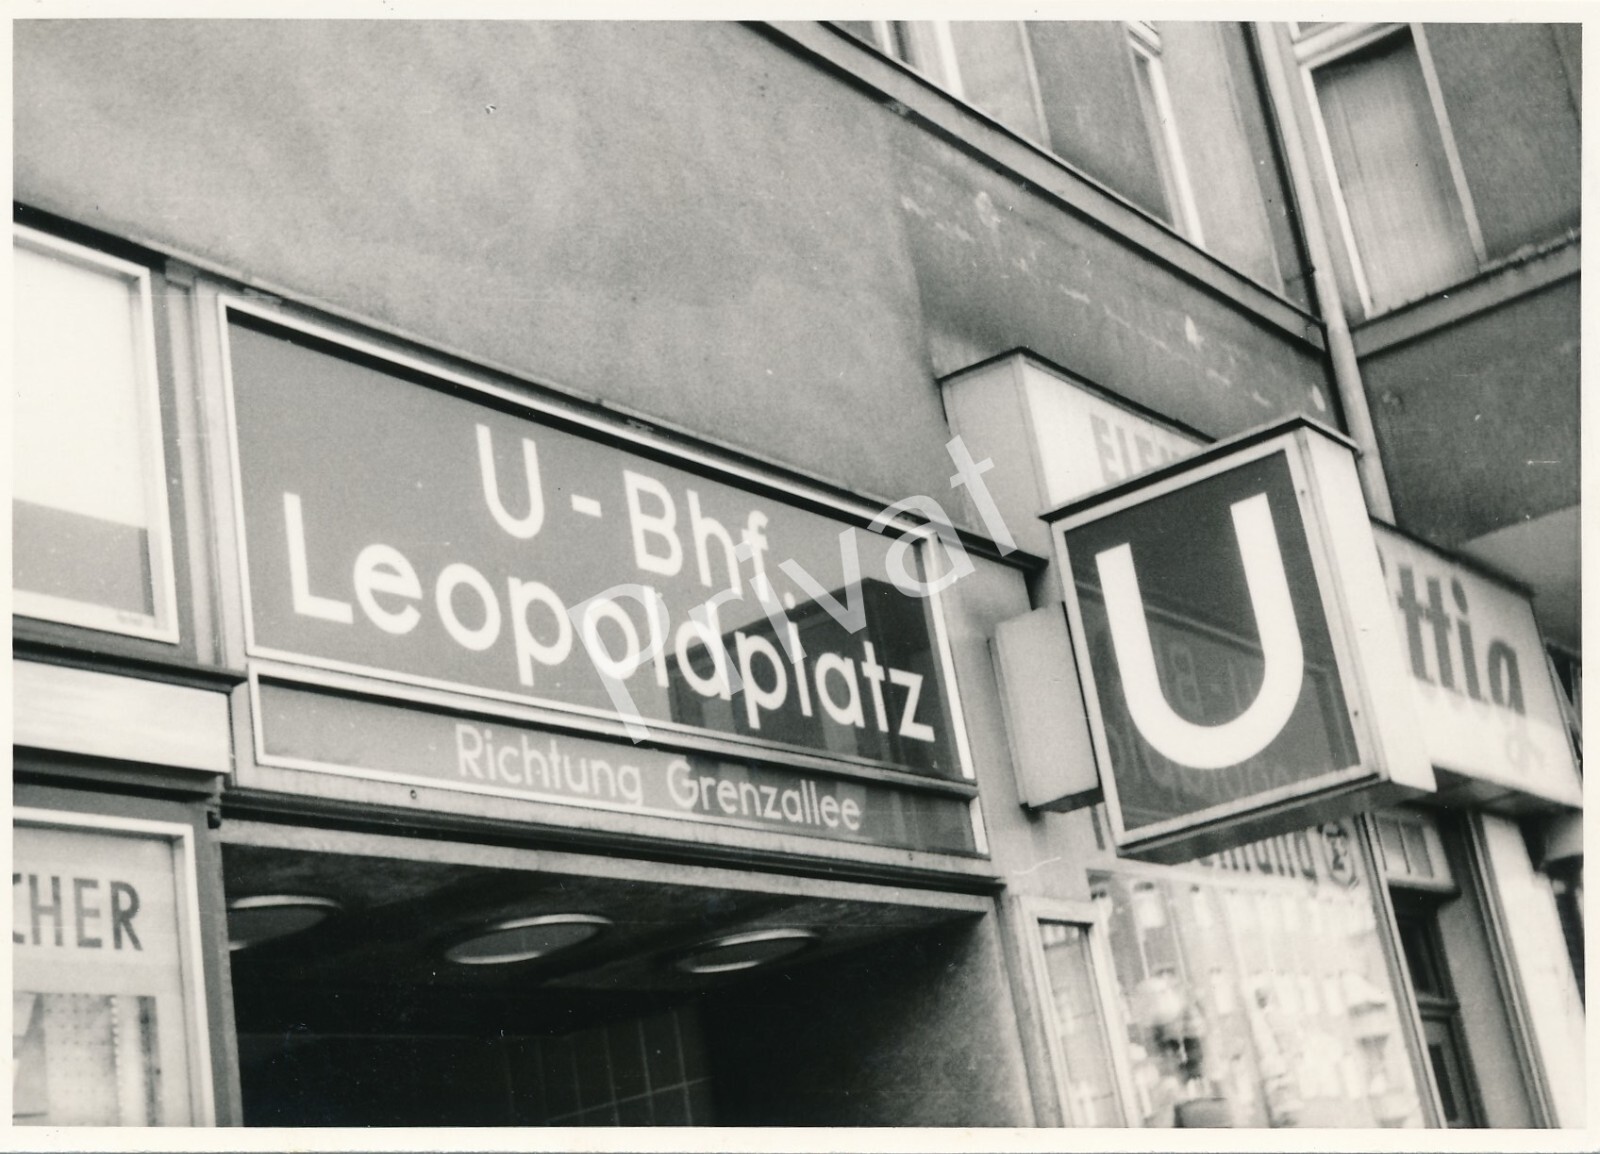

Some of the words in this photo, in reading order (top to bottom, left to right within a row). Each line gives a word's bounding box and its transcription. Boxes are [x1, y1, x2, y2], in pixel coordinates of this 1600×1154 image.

[283, 491, 935, 742] Leopoldplatz
[1094, 492, 1304, 769] U
[455, 723, 641, 806] Richtung
[666, 759, 862, 831] Grenzallee
